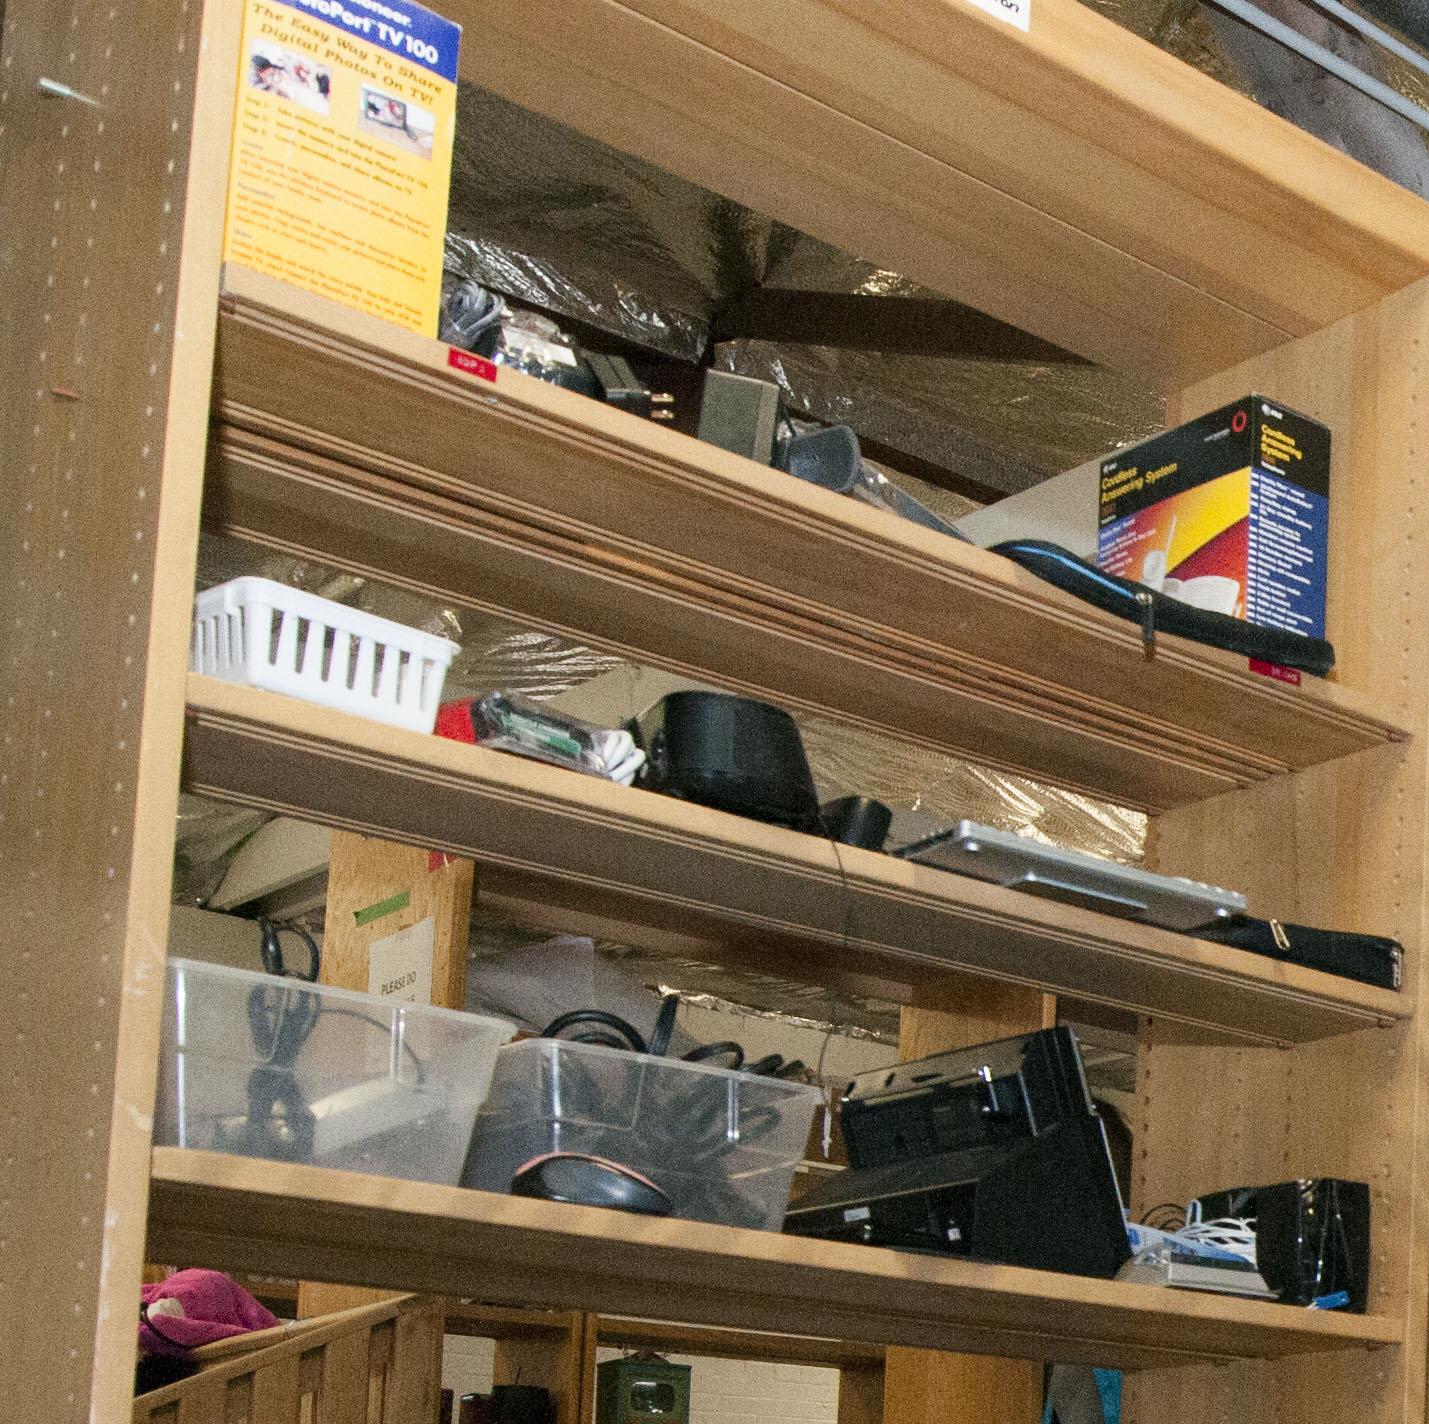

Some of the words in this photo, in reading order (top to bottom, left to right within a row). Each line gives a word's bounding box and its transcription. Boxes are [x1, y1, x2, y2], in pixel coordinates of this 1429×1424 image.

[253, 4, 284, 22] The
[291, 15, 330, 43] Easy
[337, 37, 368, 60] Way
[375, 54, 392, 69] To
[400, 66, 442, 94] Share
[261, 23, 318, 53] Digital
[325, 49, 377, 80] Photos
[383, 75, 403, 92] On
[411, 87, 434, 106] TV!
[1102, 477, 1143, 503] Answering
[1146, 463, 1177, 484] System
[382, 976, 405, 996] PLEASE
